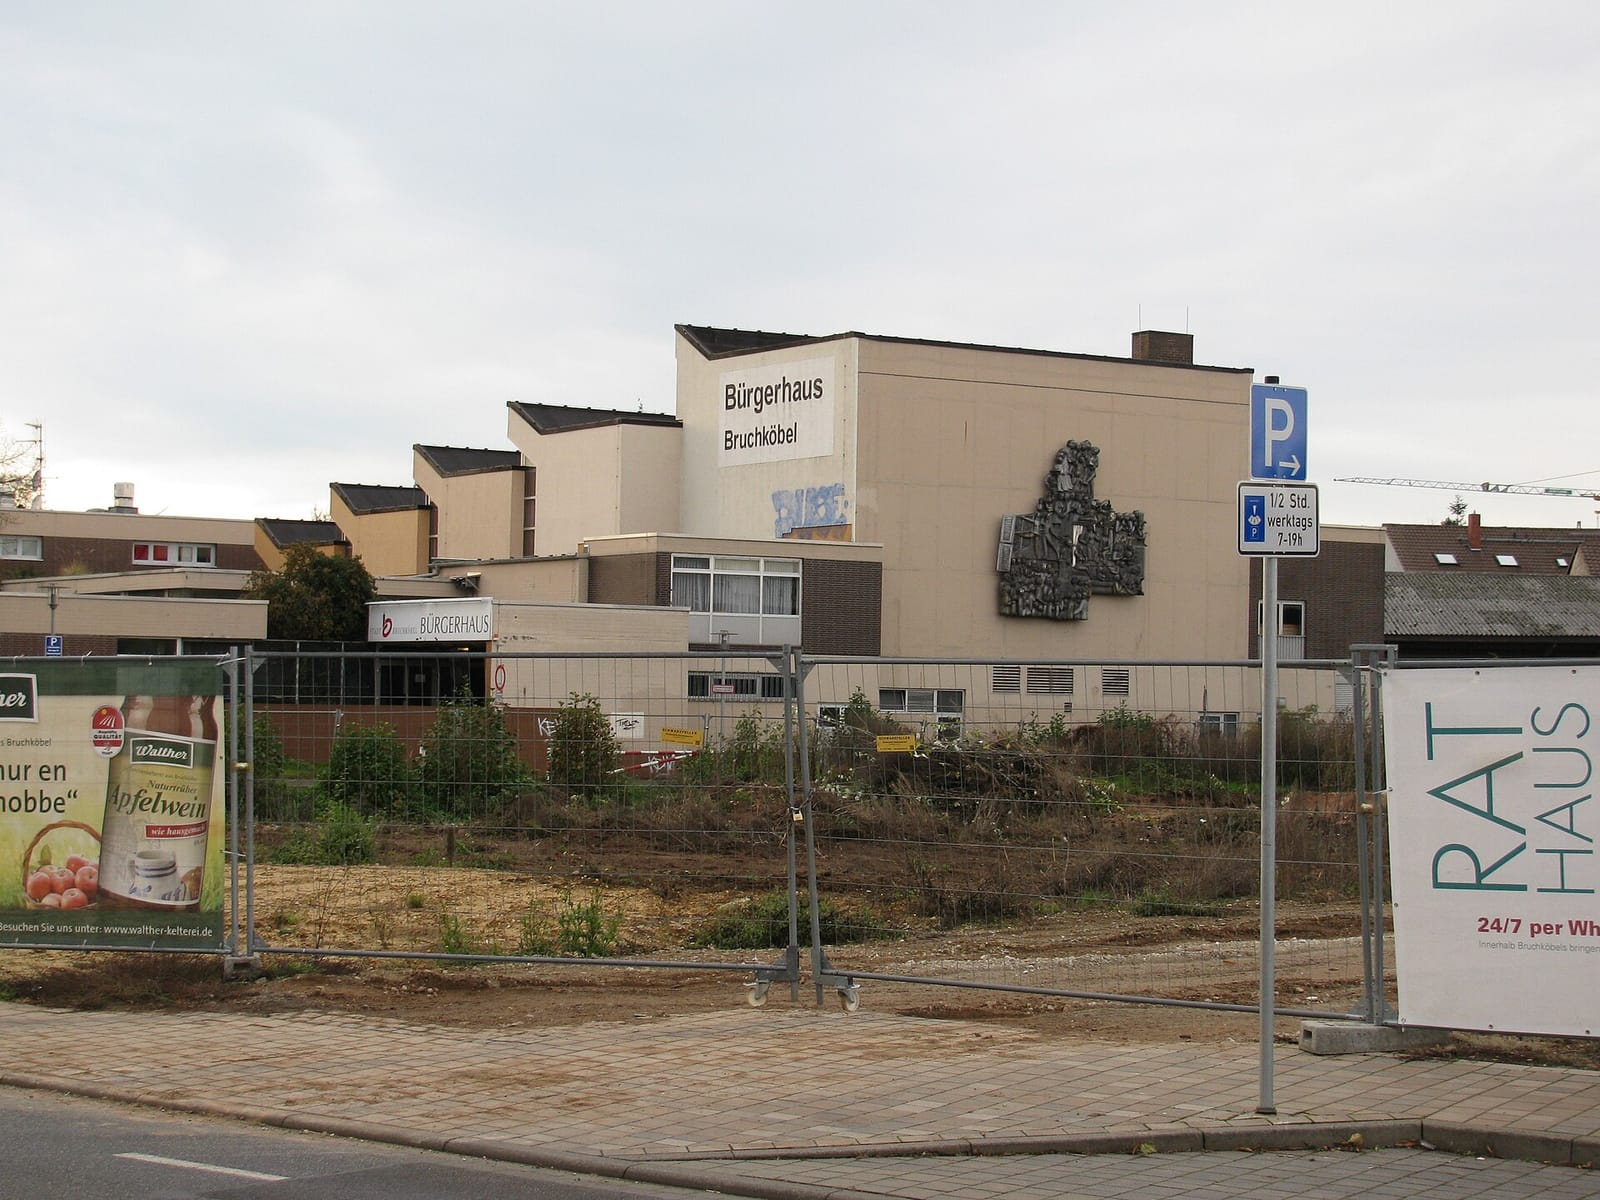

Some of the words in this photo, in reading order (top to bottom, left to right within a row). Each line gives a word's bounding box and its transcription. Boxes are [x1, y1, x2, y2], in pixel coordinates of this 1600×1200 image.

[725, 376, 823, 413] Bürgerhaus
[724, 422, 797, 450] Bruchköbel
[1265, 398, 1294, 467] P
[1270, 493, 1284, 508] 1/2
[1290, 493, 1310, 508] Std.
[1267, 514, 1313, 531] werktags
[1278, 533, 1303, 546] 7-19h
[420, 613, 489, 634] BÜRGERHAUS
[51, 637, 58, 646] P
[7, 738, 52, 747] Bruchköbel
[135, 744, 188, 760] Walther
[39, 764, 66, 781] en
[109, 784, 206, 818] Apfelwein
[1425, 702, 1528, 892] RAT
[1531, 702, 1595, 894] HAUS
[151, 827, 165, 836] wie
[0, 922, 39, 932] Besuchen
[41, 922, 54, 932] Sie
[75, 924, 102, 933] unter:
[104, 925, 213, 937] www.walther-kelterei.de
[1477, 917, 1521, 933] 24/7
[1530, 922, 1563, 938] per
[1568, 920, 1600, 937] Wh
[1479, 941, 1515, 950] Innerhalb
[1518, 942, 1567, 951] Bruchköbels
